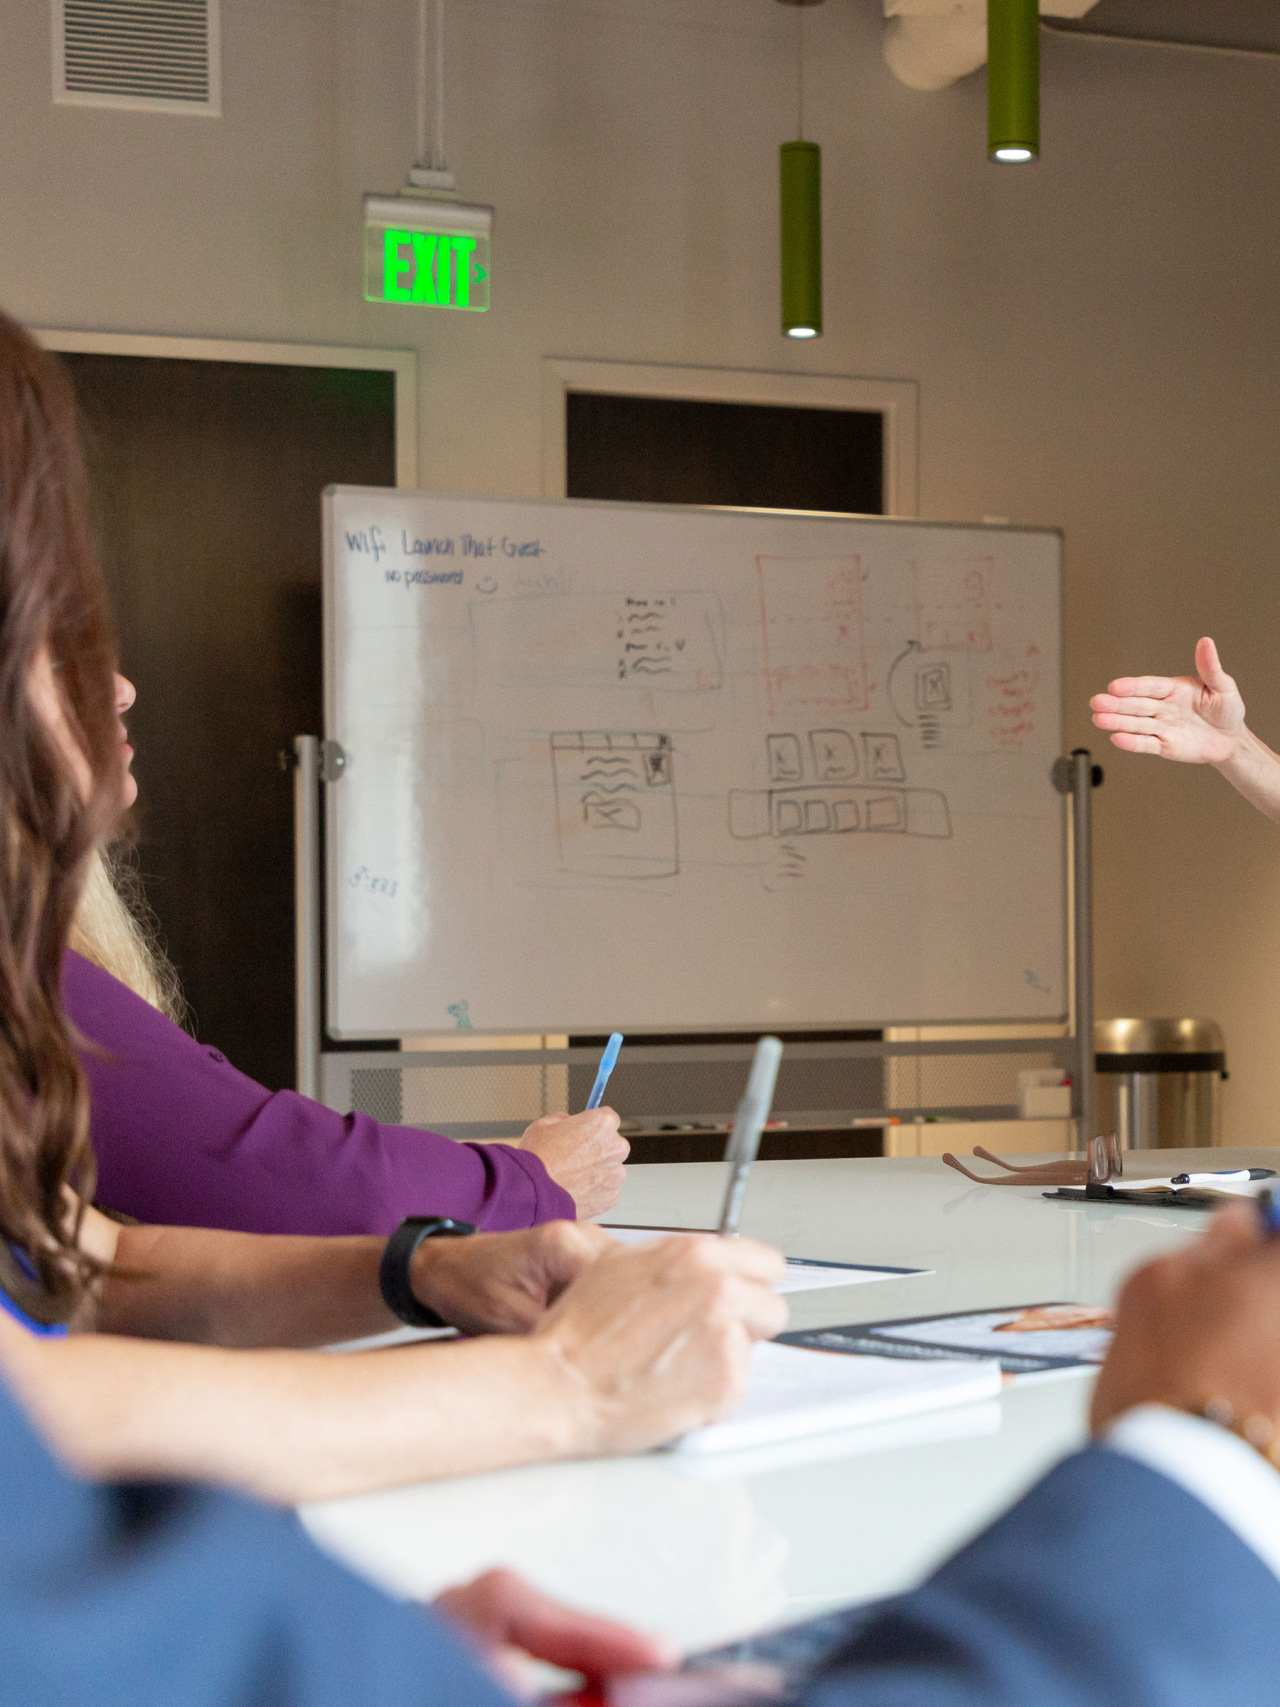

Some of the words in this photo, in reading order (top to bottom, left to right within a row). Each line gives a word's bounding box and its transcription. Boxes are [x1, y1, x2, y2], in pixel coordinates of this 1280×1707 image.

[384, 230, 476, 307] EXIT
[402, 529, 455, 556] Launch
[459, 534, 496, 557] That
[501, 536, 546, 558] Guest
[404, 569, 463, 589] password
